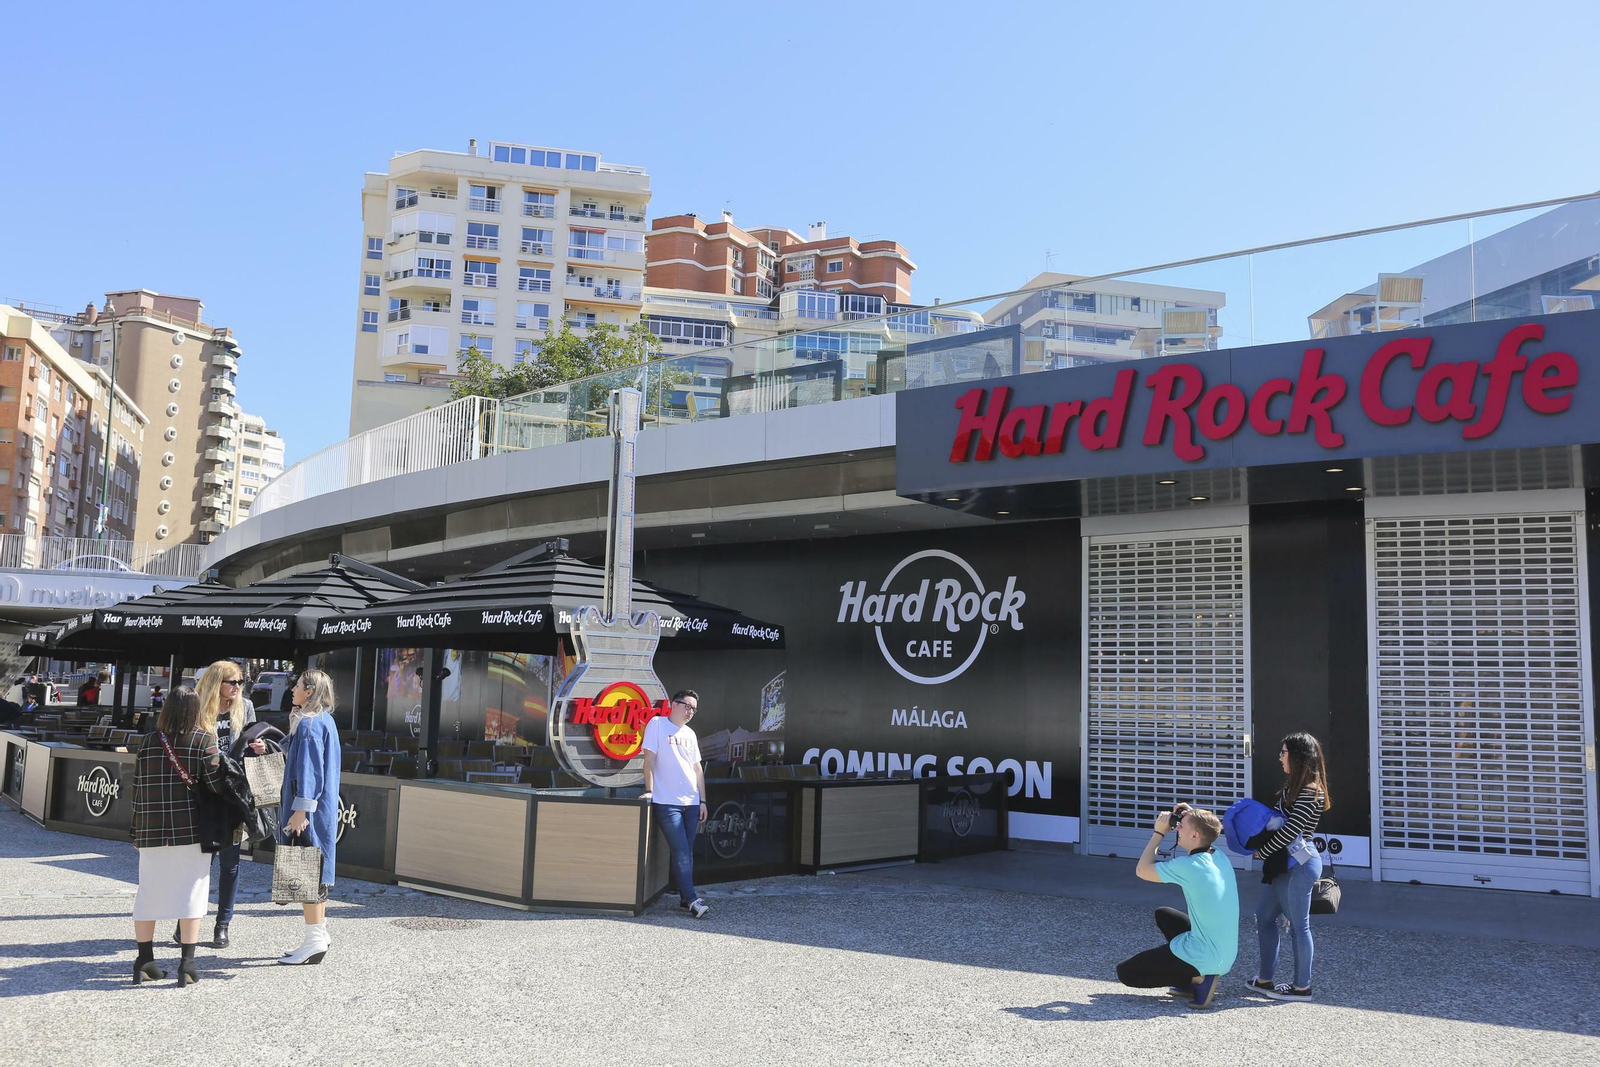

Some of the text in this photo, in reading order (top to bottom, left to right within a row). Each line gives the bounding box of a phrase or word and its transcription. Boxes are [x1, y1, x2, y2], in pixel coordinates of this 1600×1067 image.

[949, 324, 1580, 462] Hard Rock Cafe
[837, 576, 1026, 632] Hard Rock
[103, 613, 122, 623] Har
[182, 615, 223, 629] Hard Rock Cafe
[244, 618, 287, 632] Hard Rock Cafe
[321, 618, 372, 635] Hard Rock Cafe
[397, 613, 451, 629] Hard Rock Cafe
[482, 610, 543, 626] Hard Rock Cafe
[673, 616, 691, 631] Rock
[691, 618, 708, 631] Cafe
[732, 623, 780, 640] Hard Rock Cafe
[906, 640, 952, 658] CAFE
[574, 698, 627, 725] Hard
[891, 706, 968, 728] MÁLAGA
[609, 733, 638, 745] CAFE
[802, 748, 938, 779] COMING
[77, 775, 119, 799] Hard Rock
[92, 799, 103, 808] CAFE
[337, 804, 357, 828] ock
